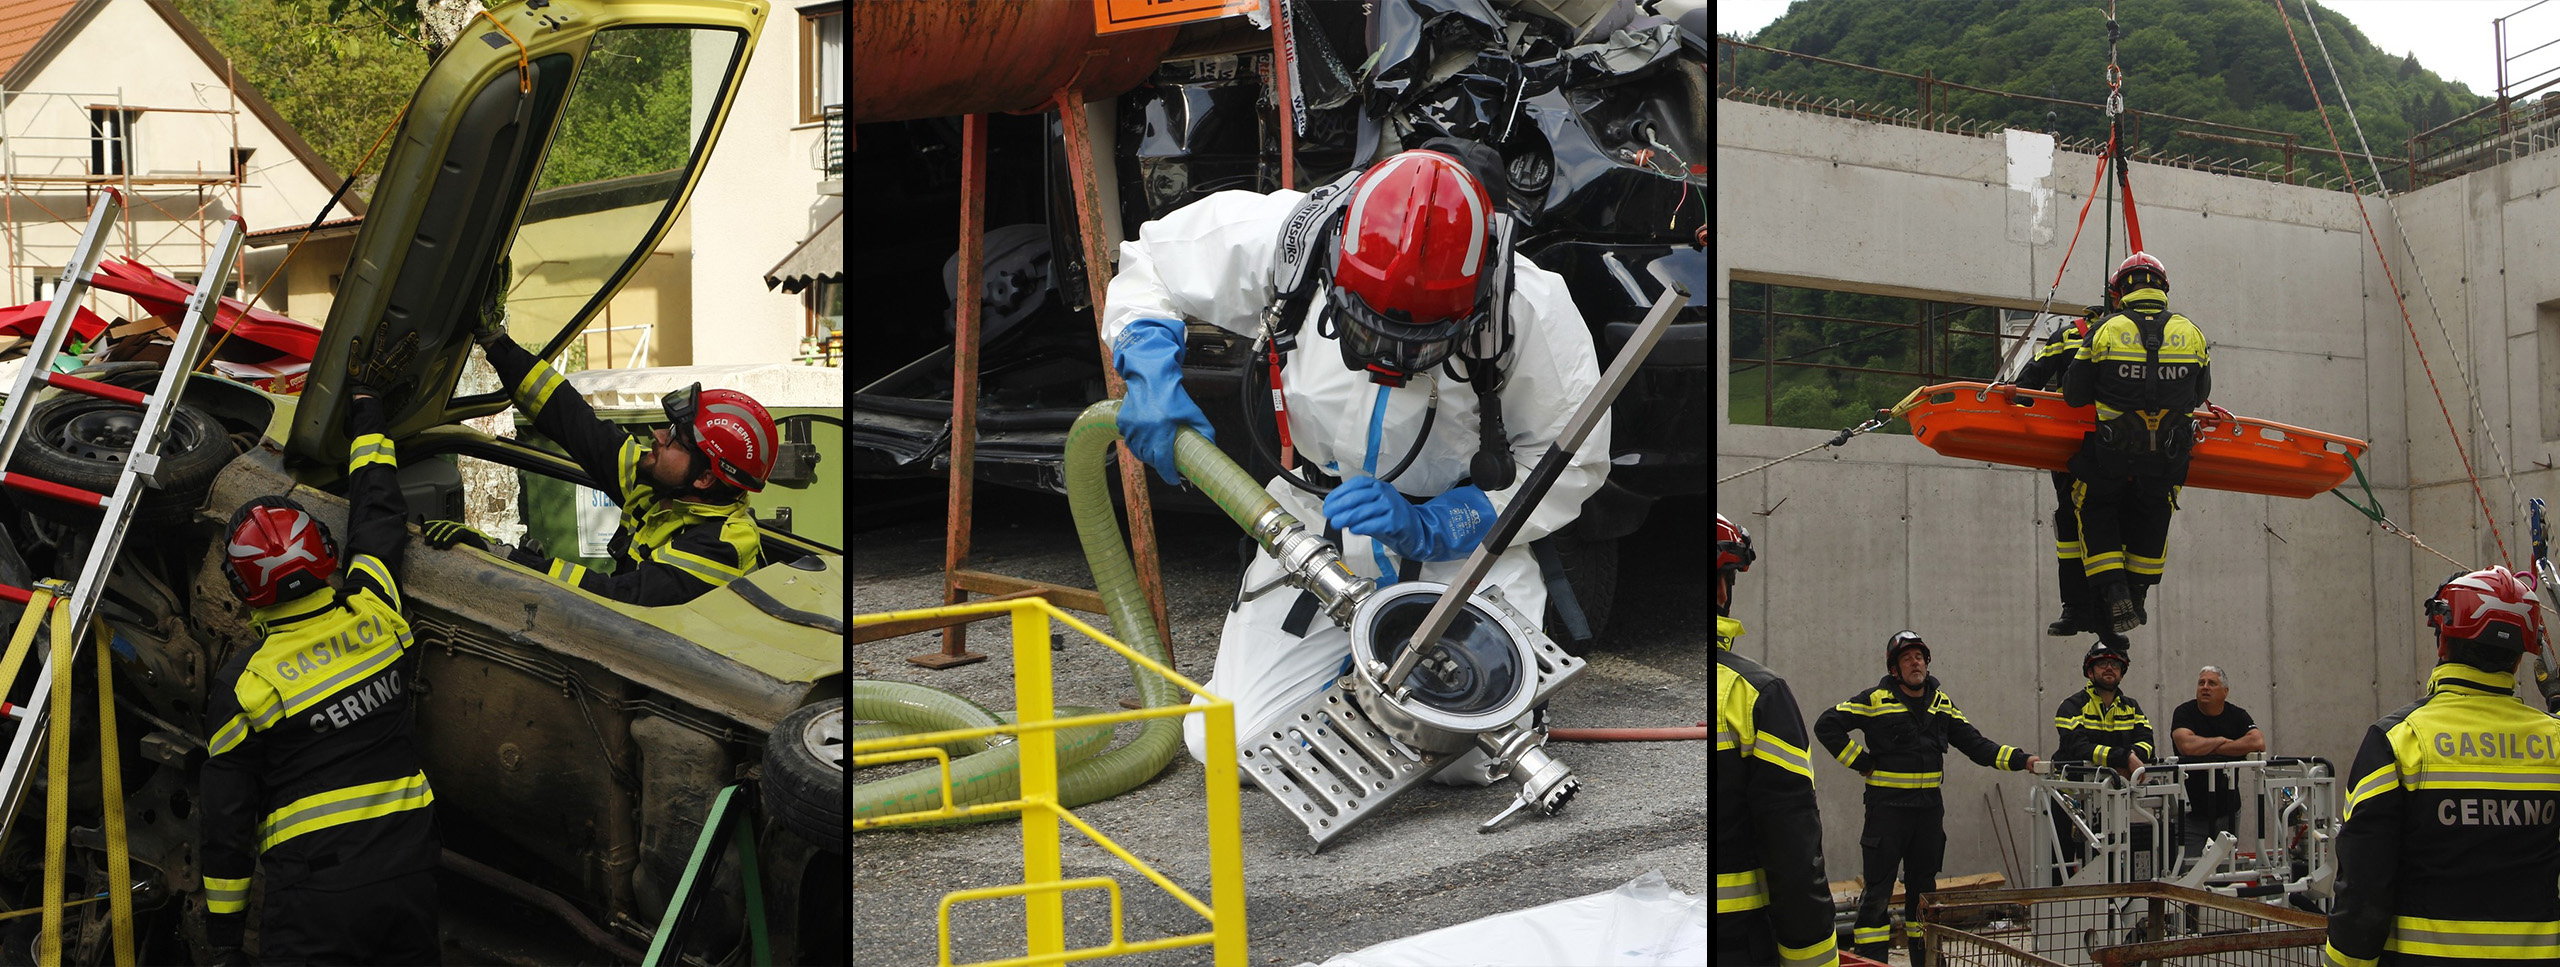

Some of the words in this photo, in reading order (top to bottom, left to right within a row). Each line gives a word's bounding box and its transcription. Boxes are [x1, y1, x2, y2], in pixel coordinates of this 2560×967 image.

[1286, 203, 1319, 265] INTERSPIRO
[2120, 331, 2186, 347] GALCI
[706, 418, 729, 428] PGD
[731, 422, 754, 460] CERKNO
[276, 614, 383, 682] GASILCI
[309, 669, 401, 734] CERKNO
[2434, 732, 2555, 759] GASILCI
[2437, 799, 2555, 826] CERKNO
